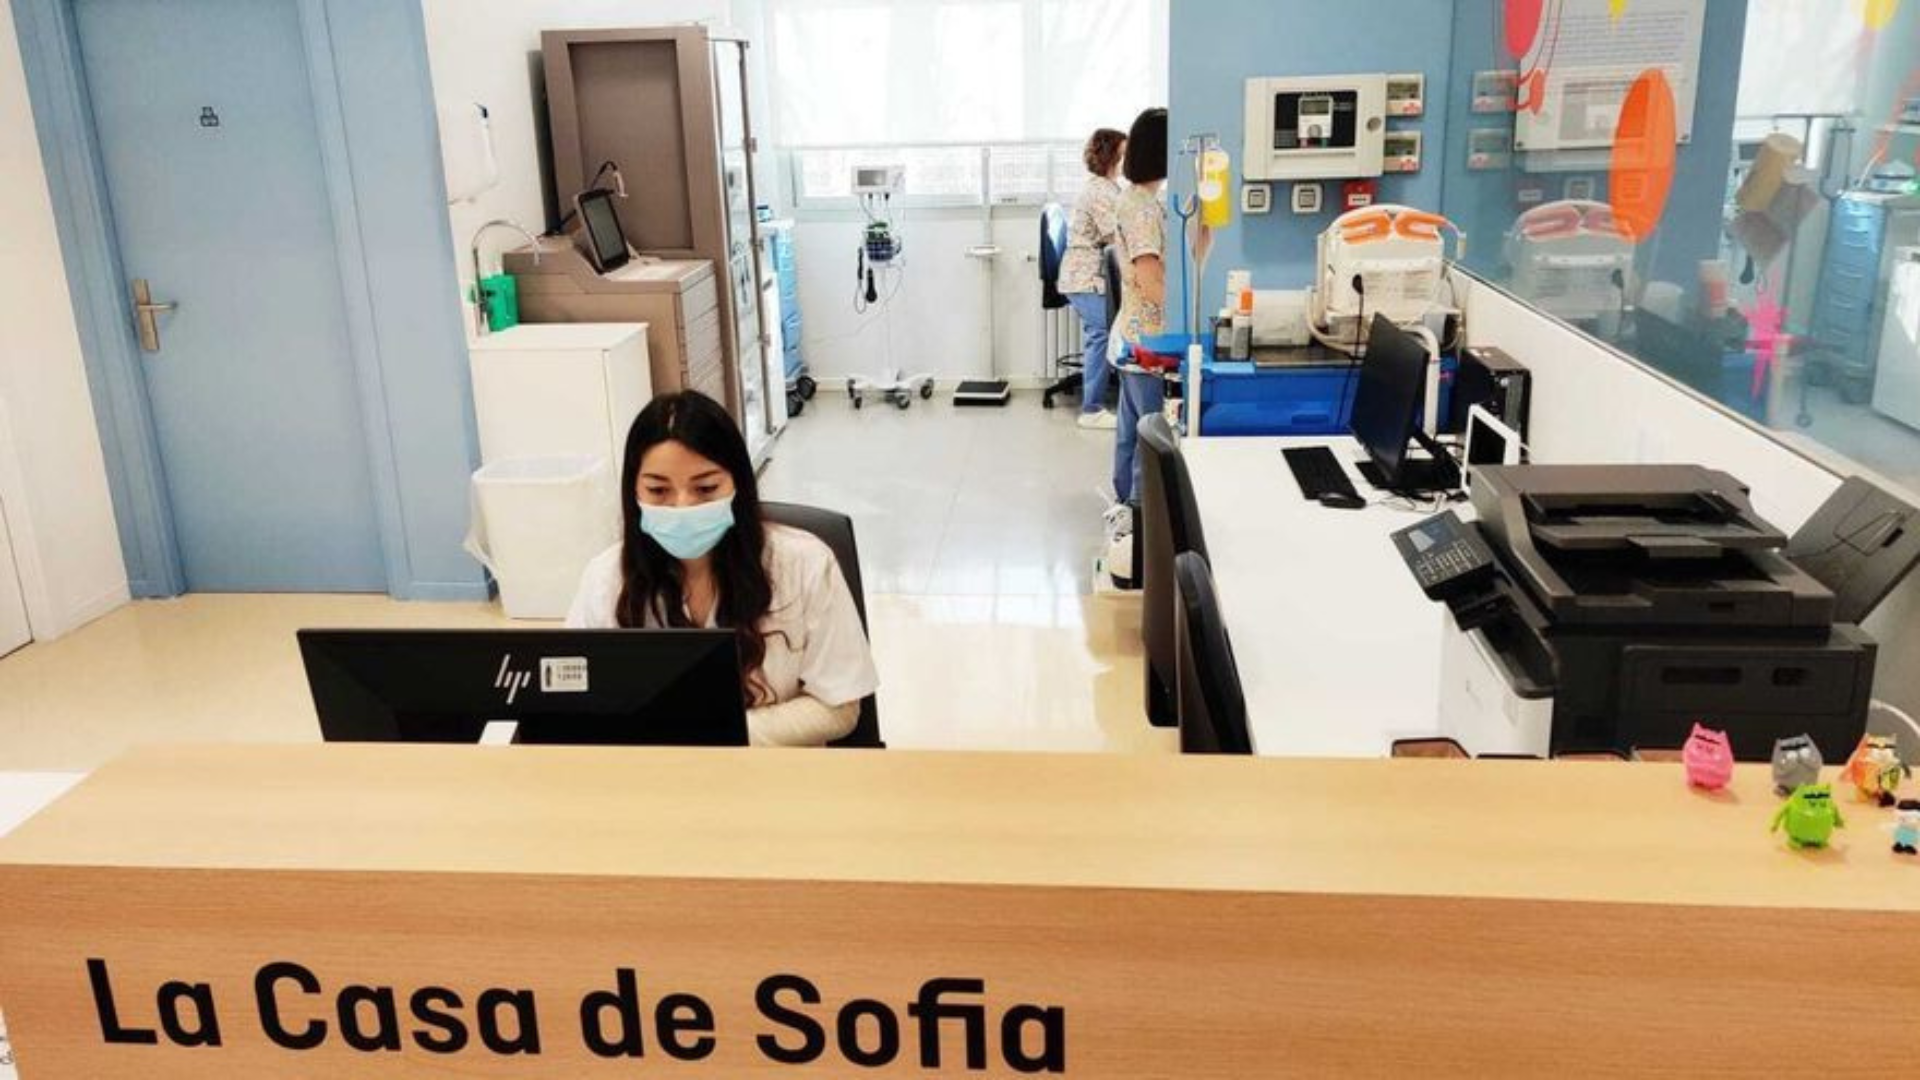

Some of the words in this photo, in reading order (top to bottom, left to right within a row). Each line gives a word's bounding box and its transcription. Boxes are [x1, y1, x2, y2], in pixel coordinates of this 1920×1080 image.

[494, 654, 531, 705] hp
[86, 958, 222, 1047] La
[254, 961, 541, 1055] Casa
[580, 968, 716, 1061] de
[754, 974, 1066, 1074] Sofia
